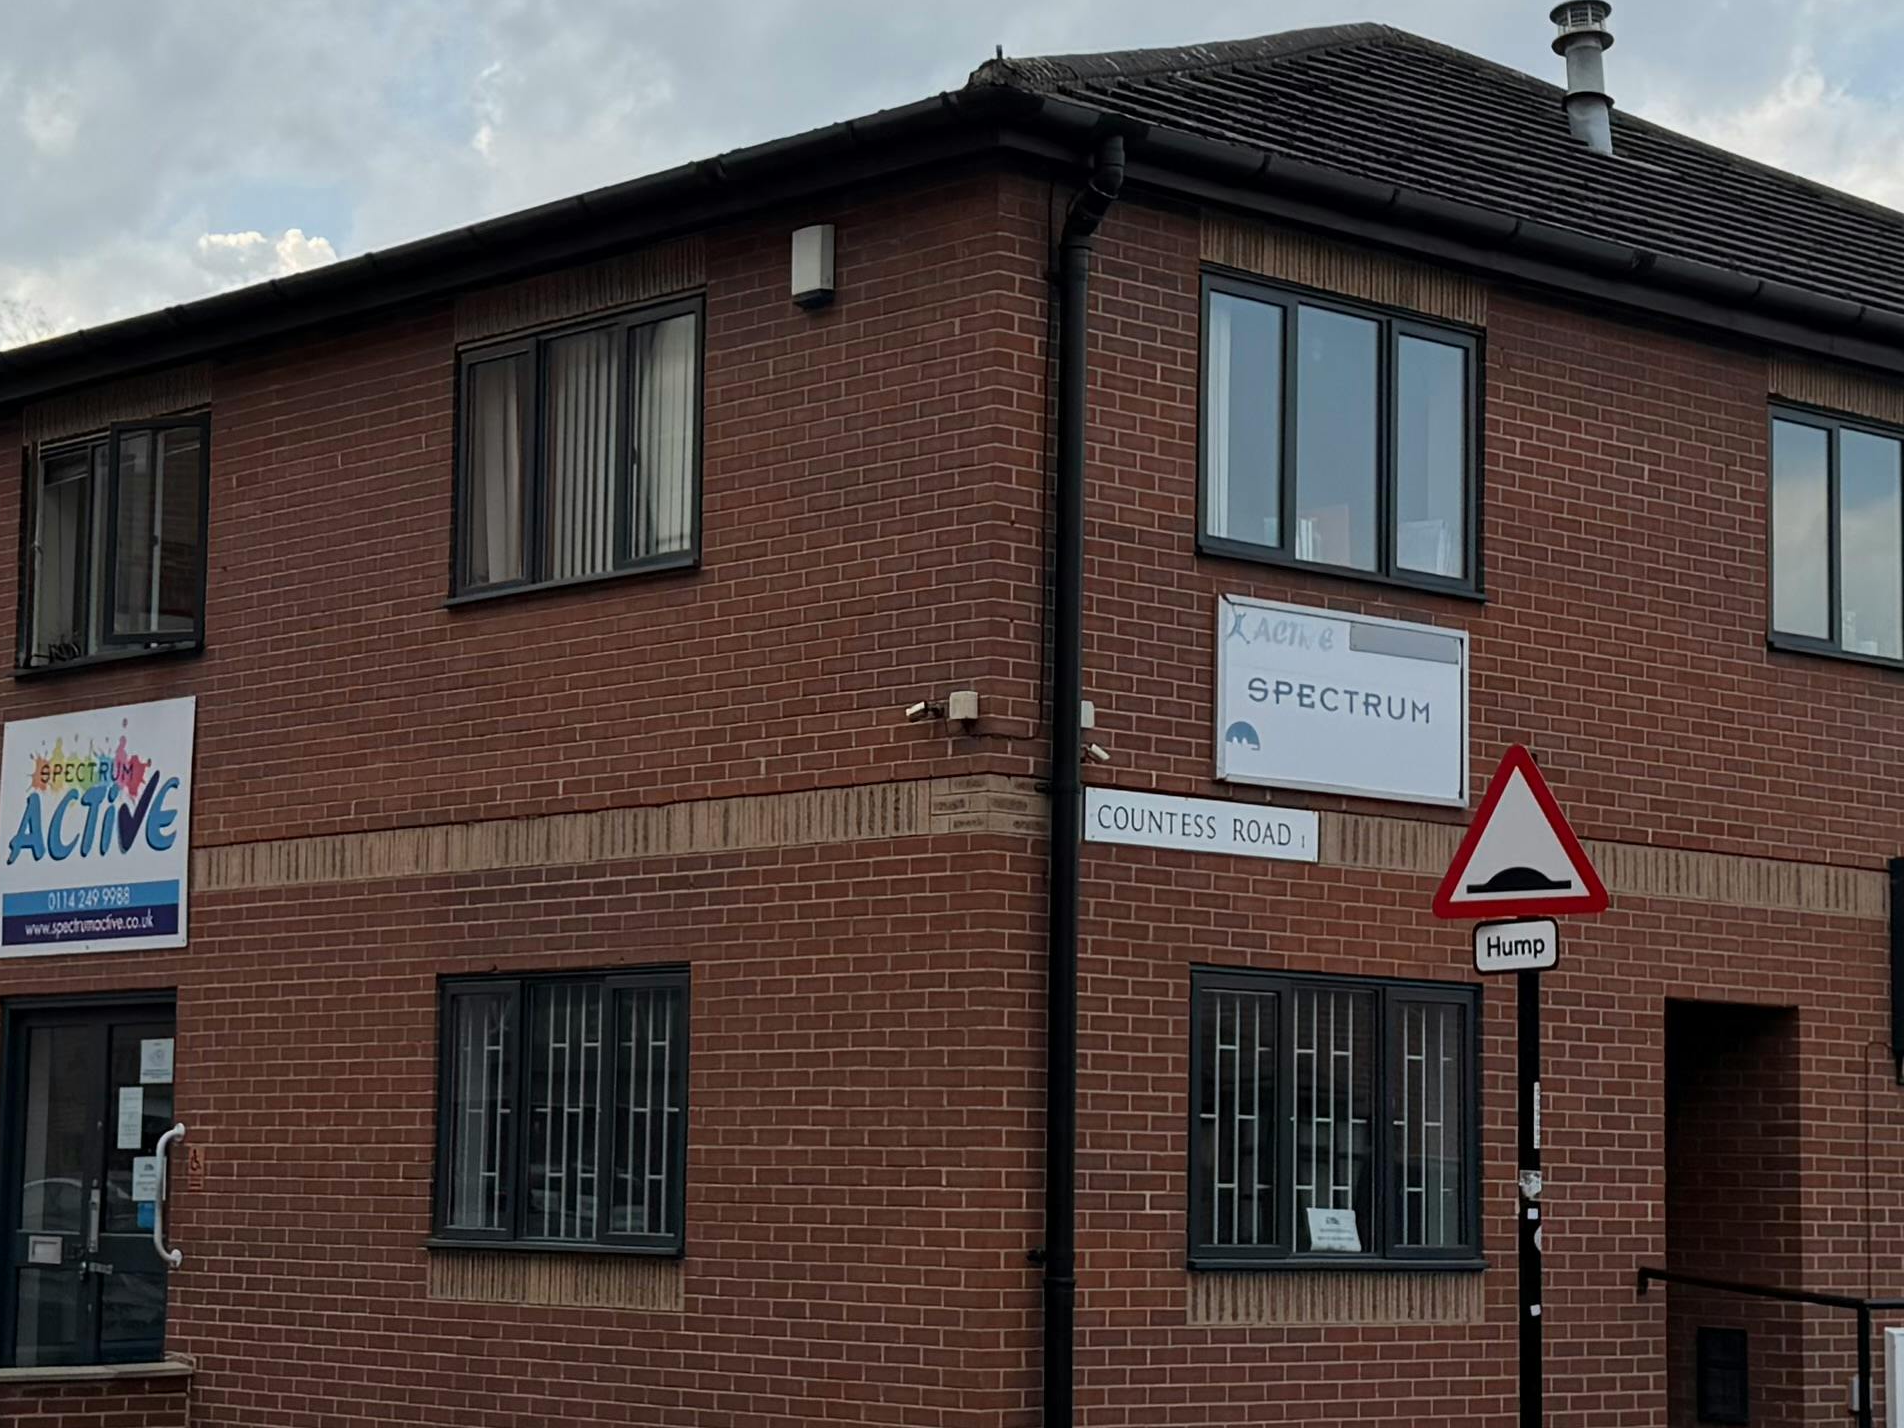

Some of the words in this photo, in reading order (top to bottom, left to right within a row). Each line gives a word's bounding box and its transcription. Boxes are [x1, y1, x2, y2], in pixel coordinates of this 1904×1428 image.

[1248, 677, 1430, 724] SPECTRUM
[40, 761, 134, 784] SPECTRUM
[1097, 804, 1217, 840] COUNTESS
[1233, 818, 1292, 847] ROAD
[48, 891, 75, 910] 0114
[78, 888, 99, 908] 249
[102, 886, 130, 906] 9988
[25, 908, 154, 939] www.spectrumactive.co.uk
[1487, 935, 1545, 959] Hump
